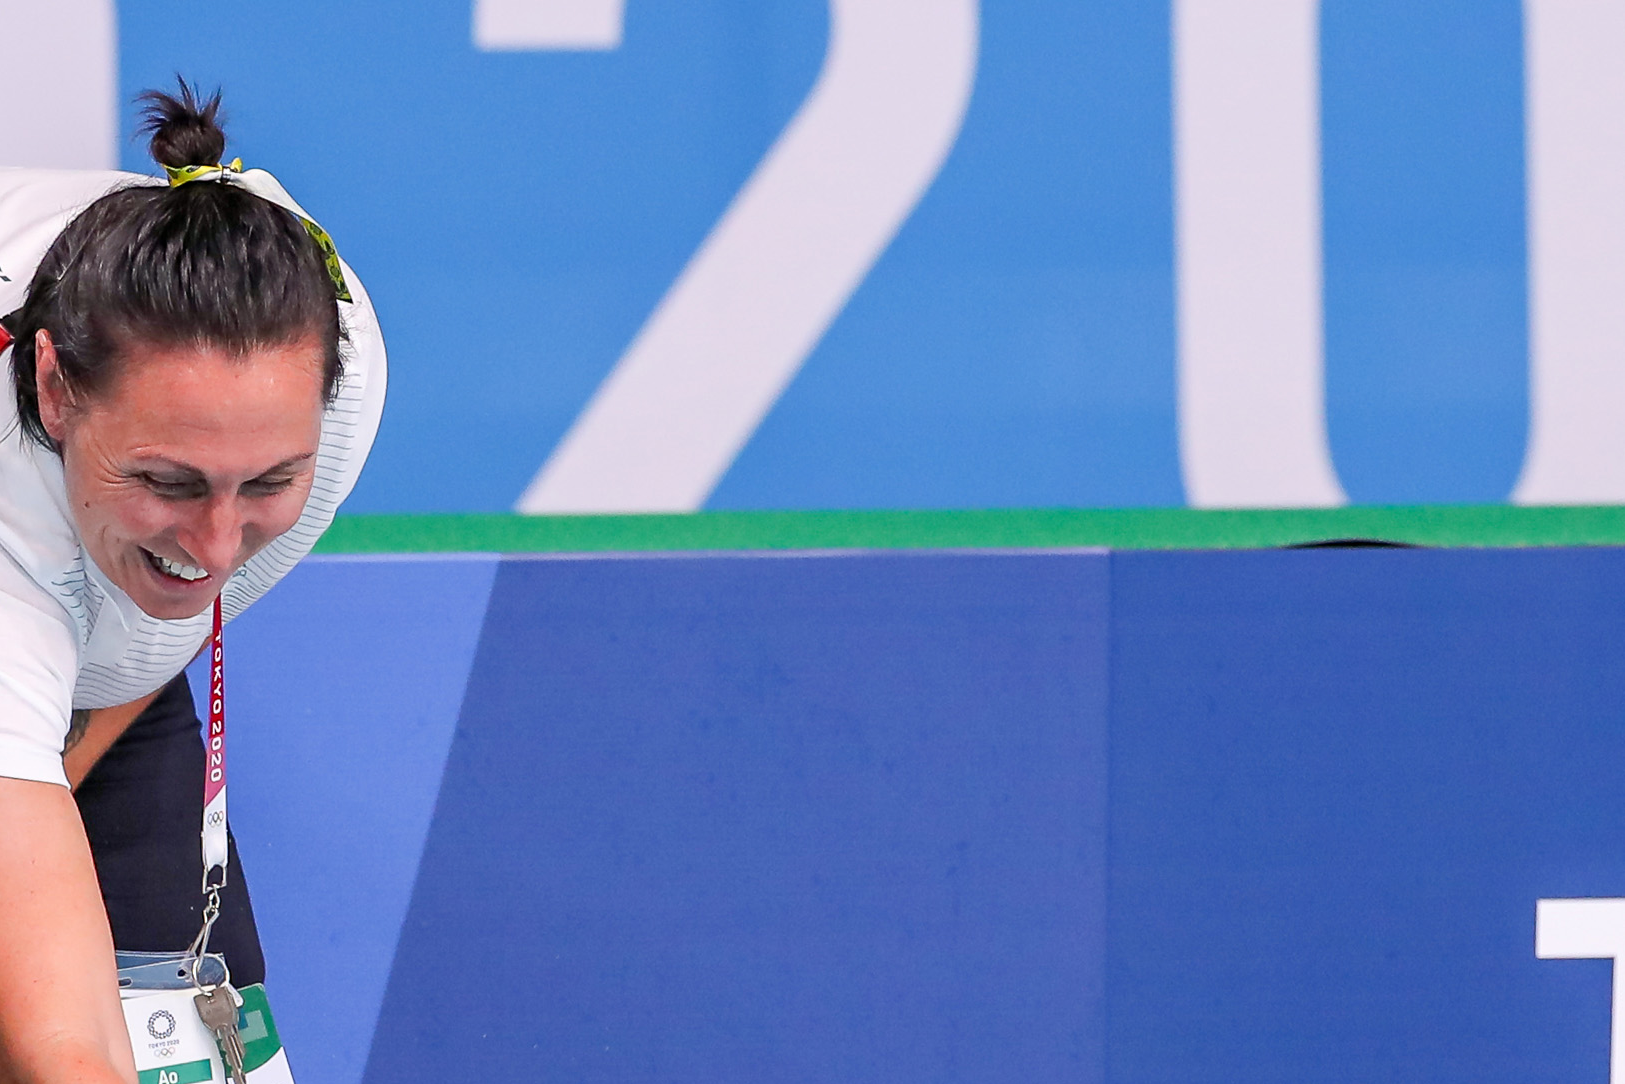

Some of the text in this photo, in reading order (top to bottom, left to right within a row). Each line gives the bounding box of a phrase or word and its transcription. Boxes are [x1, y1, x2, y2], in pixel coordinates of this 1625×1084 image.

[210, 630, 223, 783] TOKYO 2020
[148, 1038, 180, 1049] TOKYO 2020
